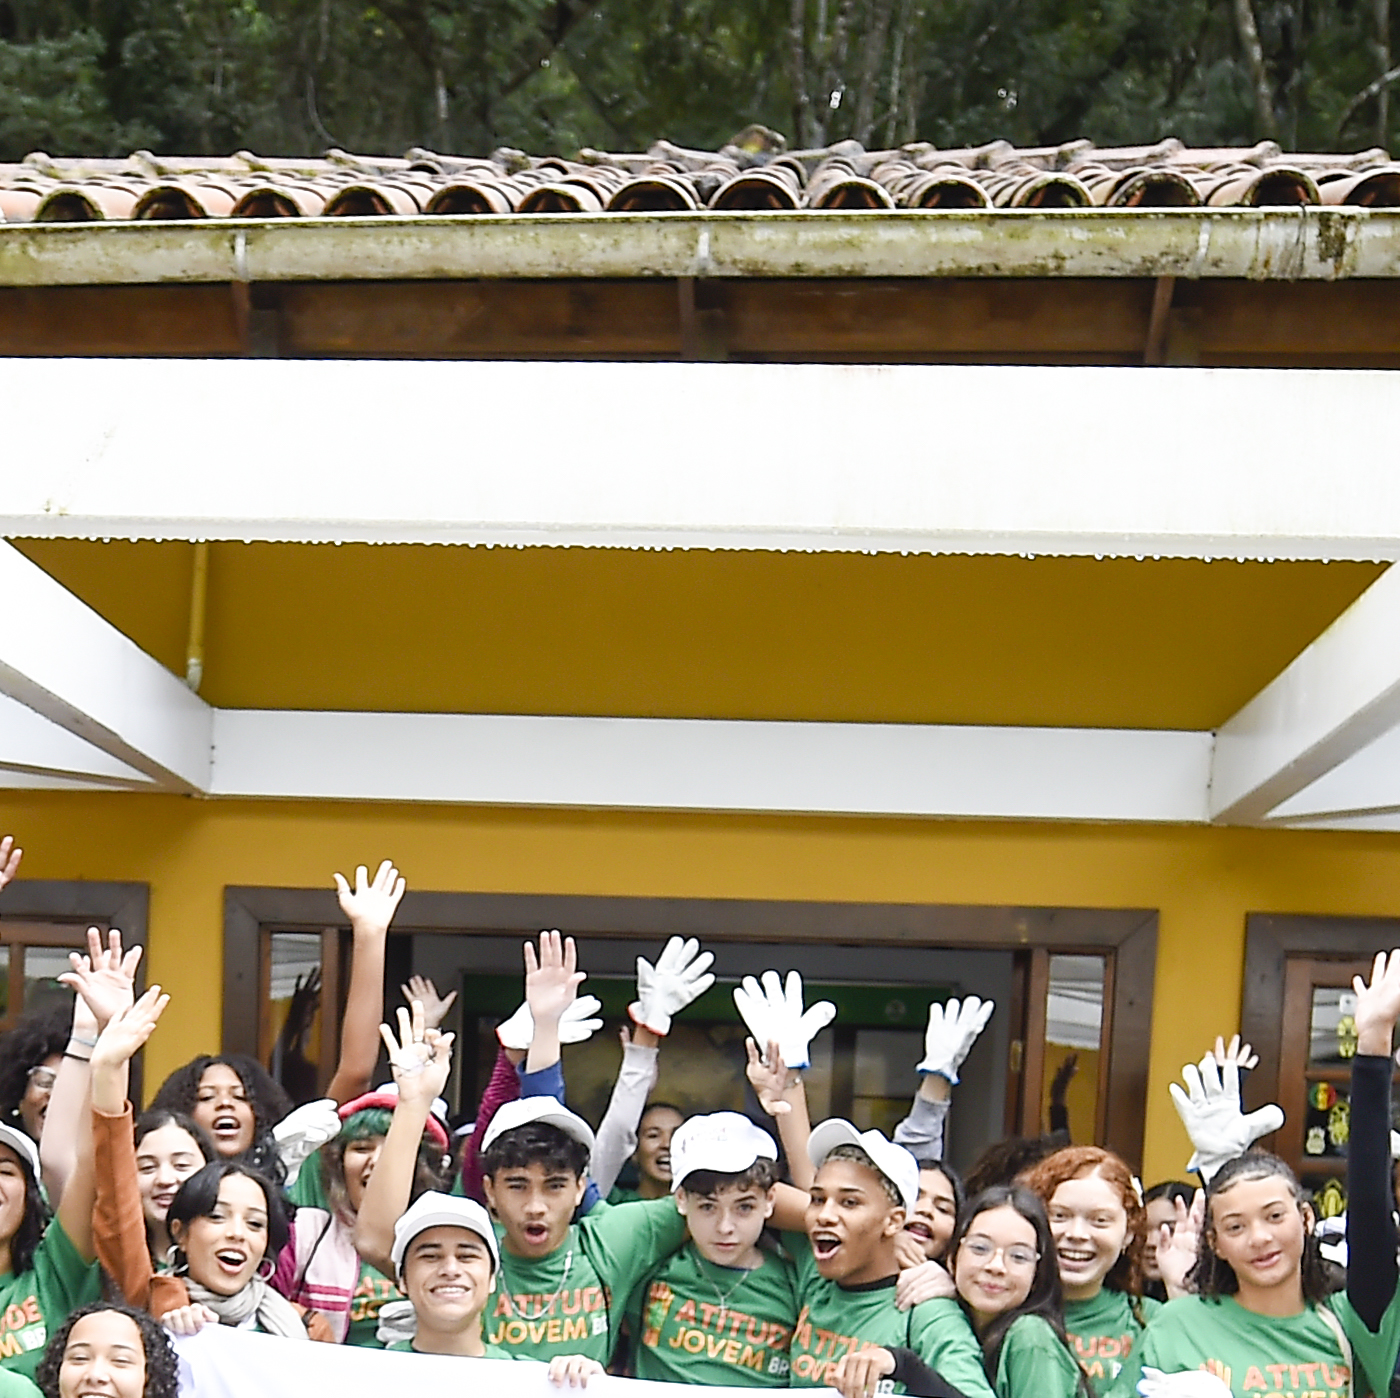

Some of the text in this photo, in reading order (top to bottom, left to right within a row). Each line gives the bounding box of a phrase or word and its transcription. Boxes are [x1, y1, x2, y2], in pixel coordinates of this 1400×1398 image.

[493, 1287, 604, 1317] ATITUD
[488, 1317, 588, 1344] JOVEM
[674, 1299, 788, 1350] ATITUD
[668, 1327, 765, 1372] JOVEM
